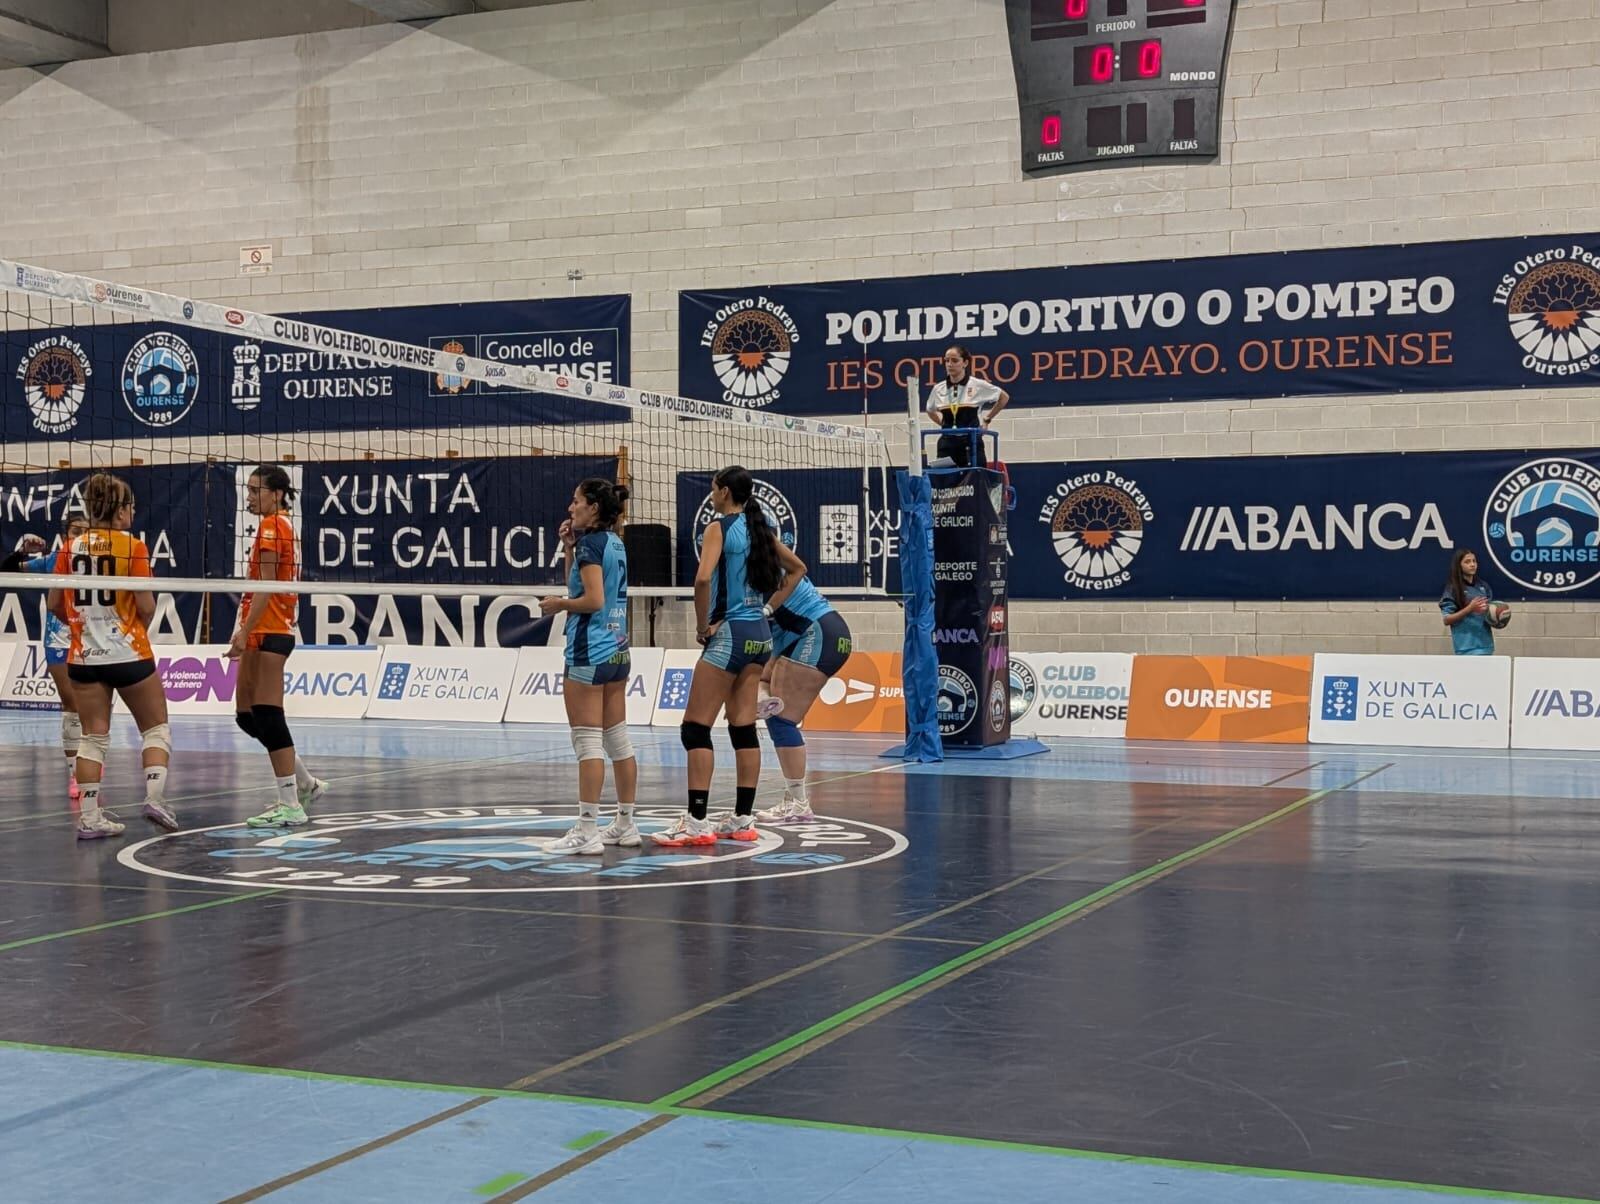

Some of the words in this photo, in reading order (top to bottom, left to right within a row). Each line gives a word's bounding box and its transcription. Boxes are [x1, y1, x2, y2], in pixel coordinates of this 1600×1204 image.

[1095, 20, 1136, 33] PERIODO
[1169, 71, 1216, 82] MONDO
[1041, 115, 1062, 146] 0
[1096, 144, 1135, 156] JUGADOR
[1169, 140, 1198, 151] FALTAS
[1037, 151, 1065, 162] FALTAS
[1493, 273, 1516, 305] IES
[1514, 247, 1565, 275] Otero
[106, 287, 143, 303] ourense
[825, 291, 1186, 346] POLIDEPORTIVO
[1196, 289, 1232, 326] O
[1243, 276, 1455, 323] POMPEO
[700, 320, 718, 347] IES
[715, 298, 754, 322] Otero
[757, 296, 800, 343] Pedrayo
[273, 320, 309, 343] CLUB
[313, 326, 377, 356] VOLEIBOL
[380, 342, 435, 367] OURENSE
[486, 338, 565, 361] Concello
[569, 337, 594, 357] de
[16, 357, 29, 381] IES
[60, 335, 92, 376] Pedrayo
[127, 343, 148, 372] CLUB
[826, 360, 883, 392] IES
[894, 351, 1021, 389] OTRO
[1238, 331, 1453, 373] OURENSE
[1522, 353, 1600, 376] Ourense
[283, 376, 393, 399] OURENSE
[136, 395, 184, 407] OURENSE
[640, 392, 661, 408] CLUB
[662, 395, 699, 415] VOLEIBOL
[699, 403, 733, 420] OURENSE
[722, 389, 780, 408] Ourense
[33, 416, 78, 433] Ourense
[149, 411, 172, 422] 1989
[319, 472, 481, 515] XUNTA
[1039, 495, 1060, 524] IES
[1056, 472, 1100, 496] Otero
[1104, 470, 1154, 521] Pedrayo
[1494, 472, 1531, 513] CLUB
[1533, 463, 1600, 502] VOLEIB
[0, 483, 91, 522] NTA
[751, 483, 791, 525] LEIBOL
[941, 516, 974, 528] GALICIA
[318, 527, 375, 568] DE
[1510, 548, 1598, 563] OURENSE
[935, 561, 978, 571] DEPORTE
[934, 571, 973, 581] GALEGO
[1064, 570, 1131, 590] Ourense
[1533, 570, 1576, 585] 1989
[932, 627, 979, 645] ANCA
[170, 670, 207, 680] violencia
[413, 666, 469, 682] XUNTA
[939, 668, 974, 696] OLEIBOL
[1008, 661, 1034, 690] LEIBOL
[1042, 665, 1096, 681] CLUB
[173, 680, 202, 689] xénero
[283, 671, 368, 696] BANCA
[409, 684, 432, 698] DE
[434, 684, 500, 700] GALICIA
[1040, 684, 1129, 701] VOLEIBOL
[1367, 680, 1448, 698] XUNTA
[1164, 688, 1272, 708] OURENSE
[937, 712, 965, 722] RENSE
[1038, 704, 1128, 721] OURENSE
[1365, 702, 1395, 718] DE
[1403, 702, 1498, 721] GALICIA
[939, 724, 956, 733] 989
[224, 866, 472, 888] 1989
